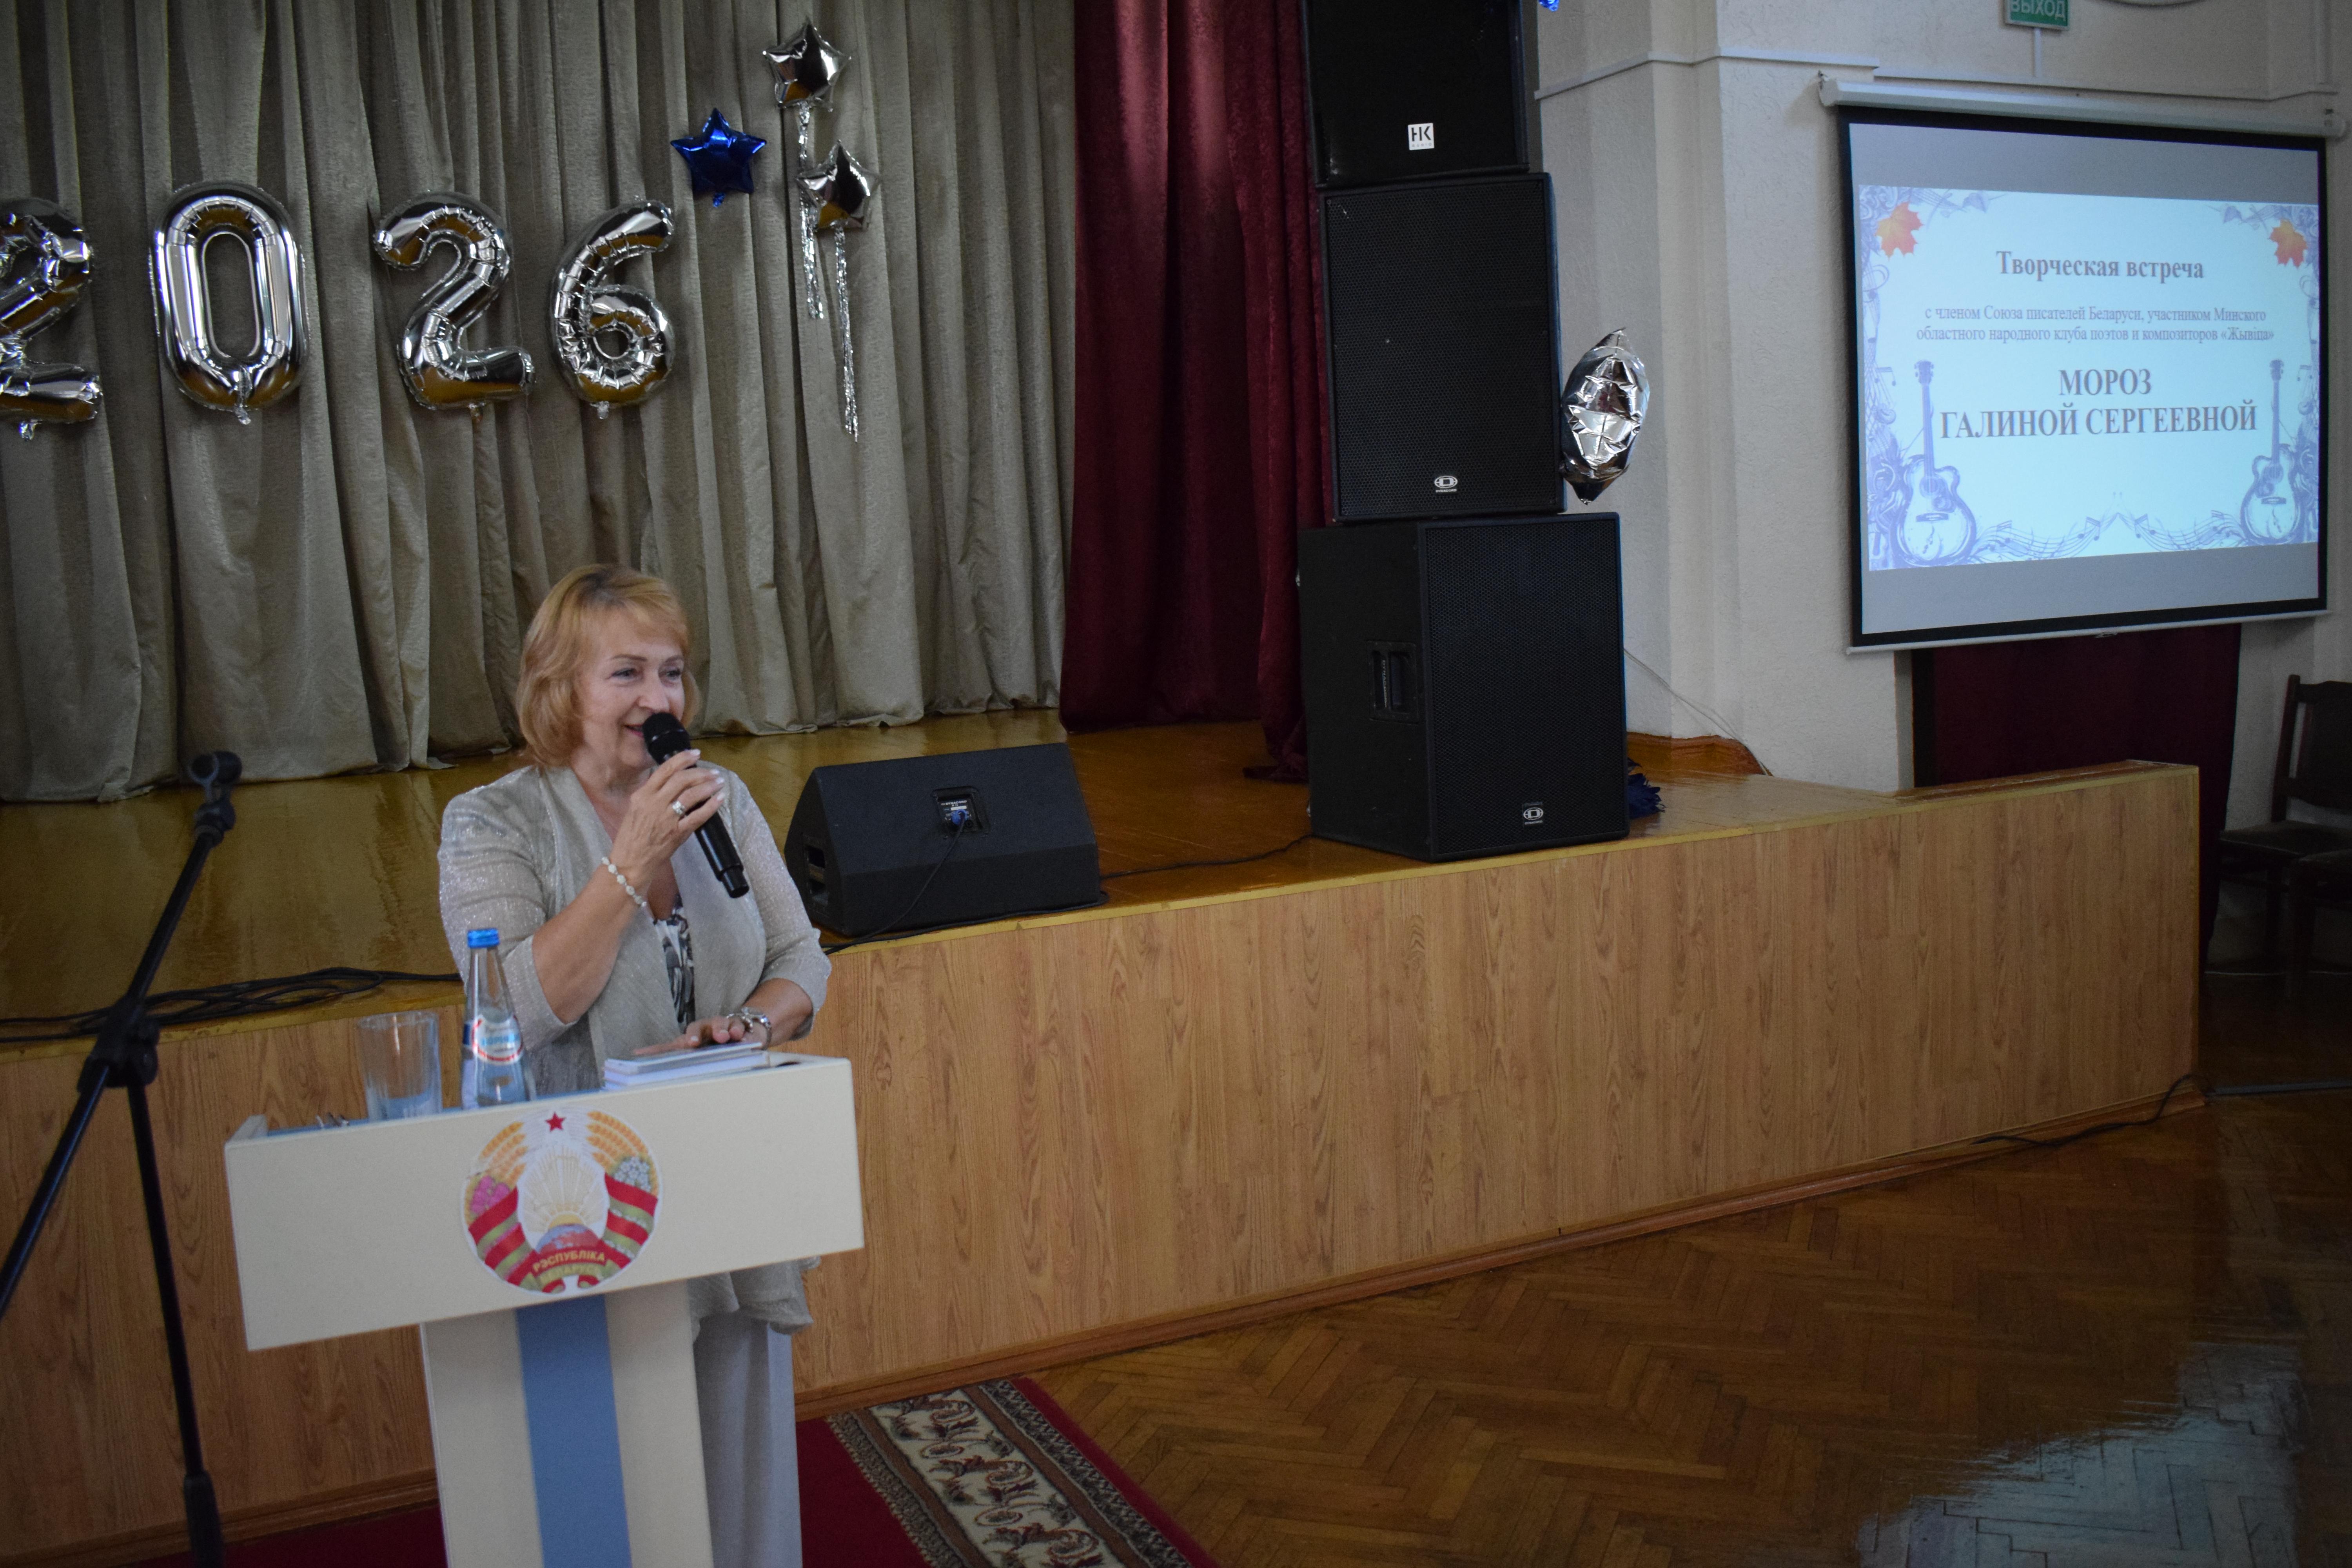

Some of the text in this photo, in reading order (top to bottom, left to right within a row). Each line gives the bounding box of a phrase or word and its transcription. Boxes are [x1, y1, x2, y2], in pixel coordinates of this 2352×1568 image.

[2011, 0, 2066, 21] ВЫХОД
[1411, 126, 1431, 142] HK
[1996, 250, 2204, 284] Творческая встреча
[0, 181, 675, 423] 2026
[1925, 305, 2266, 324] с членом Союза писателей Беларуси, участником Минского
[1916, 325, 1986, 340] областного
[1989, 329, 2051, 344] народного
[2054, 326, 2087, 343] клуба
[2090, 330, 2128, 340] поэтов
[2132, 330, 2139, 340] и
[2142, 330, 2218, 343] композиторов
[2058, 369, 2152, 396] МОРОЗ
[1940, 399, 2258, 439] ГАЛИНОЙ СЕРГЕЕВНОЙ
[533, 1250, 605, 1272] РЭСПУБЛІКА
